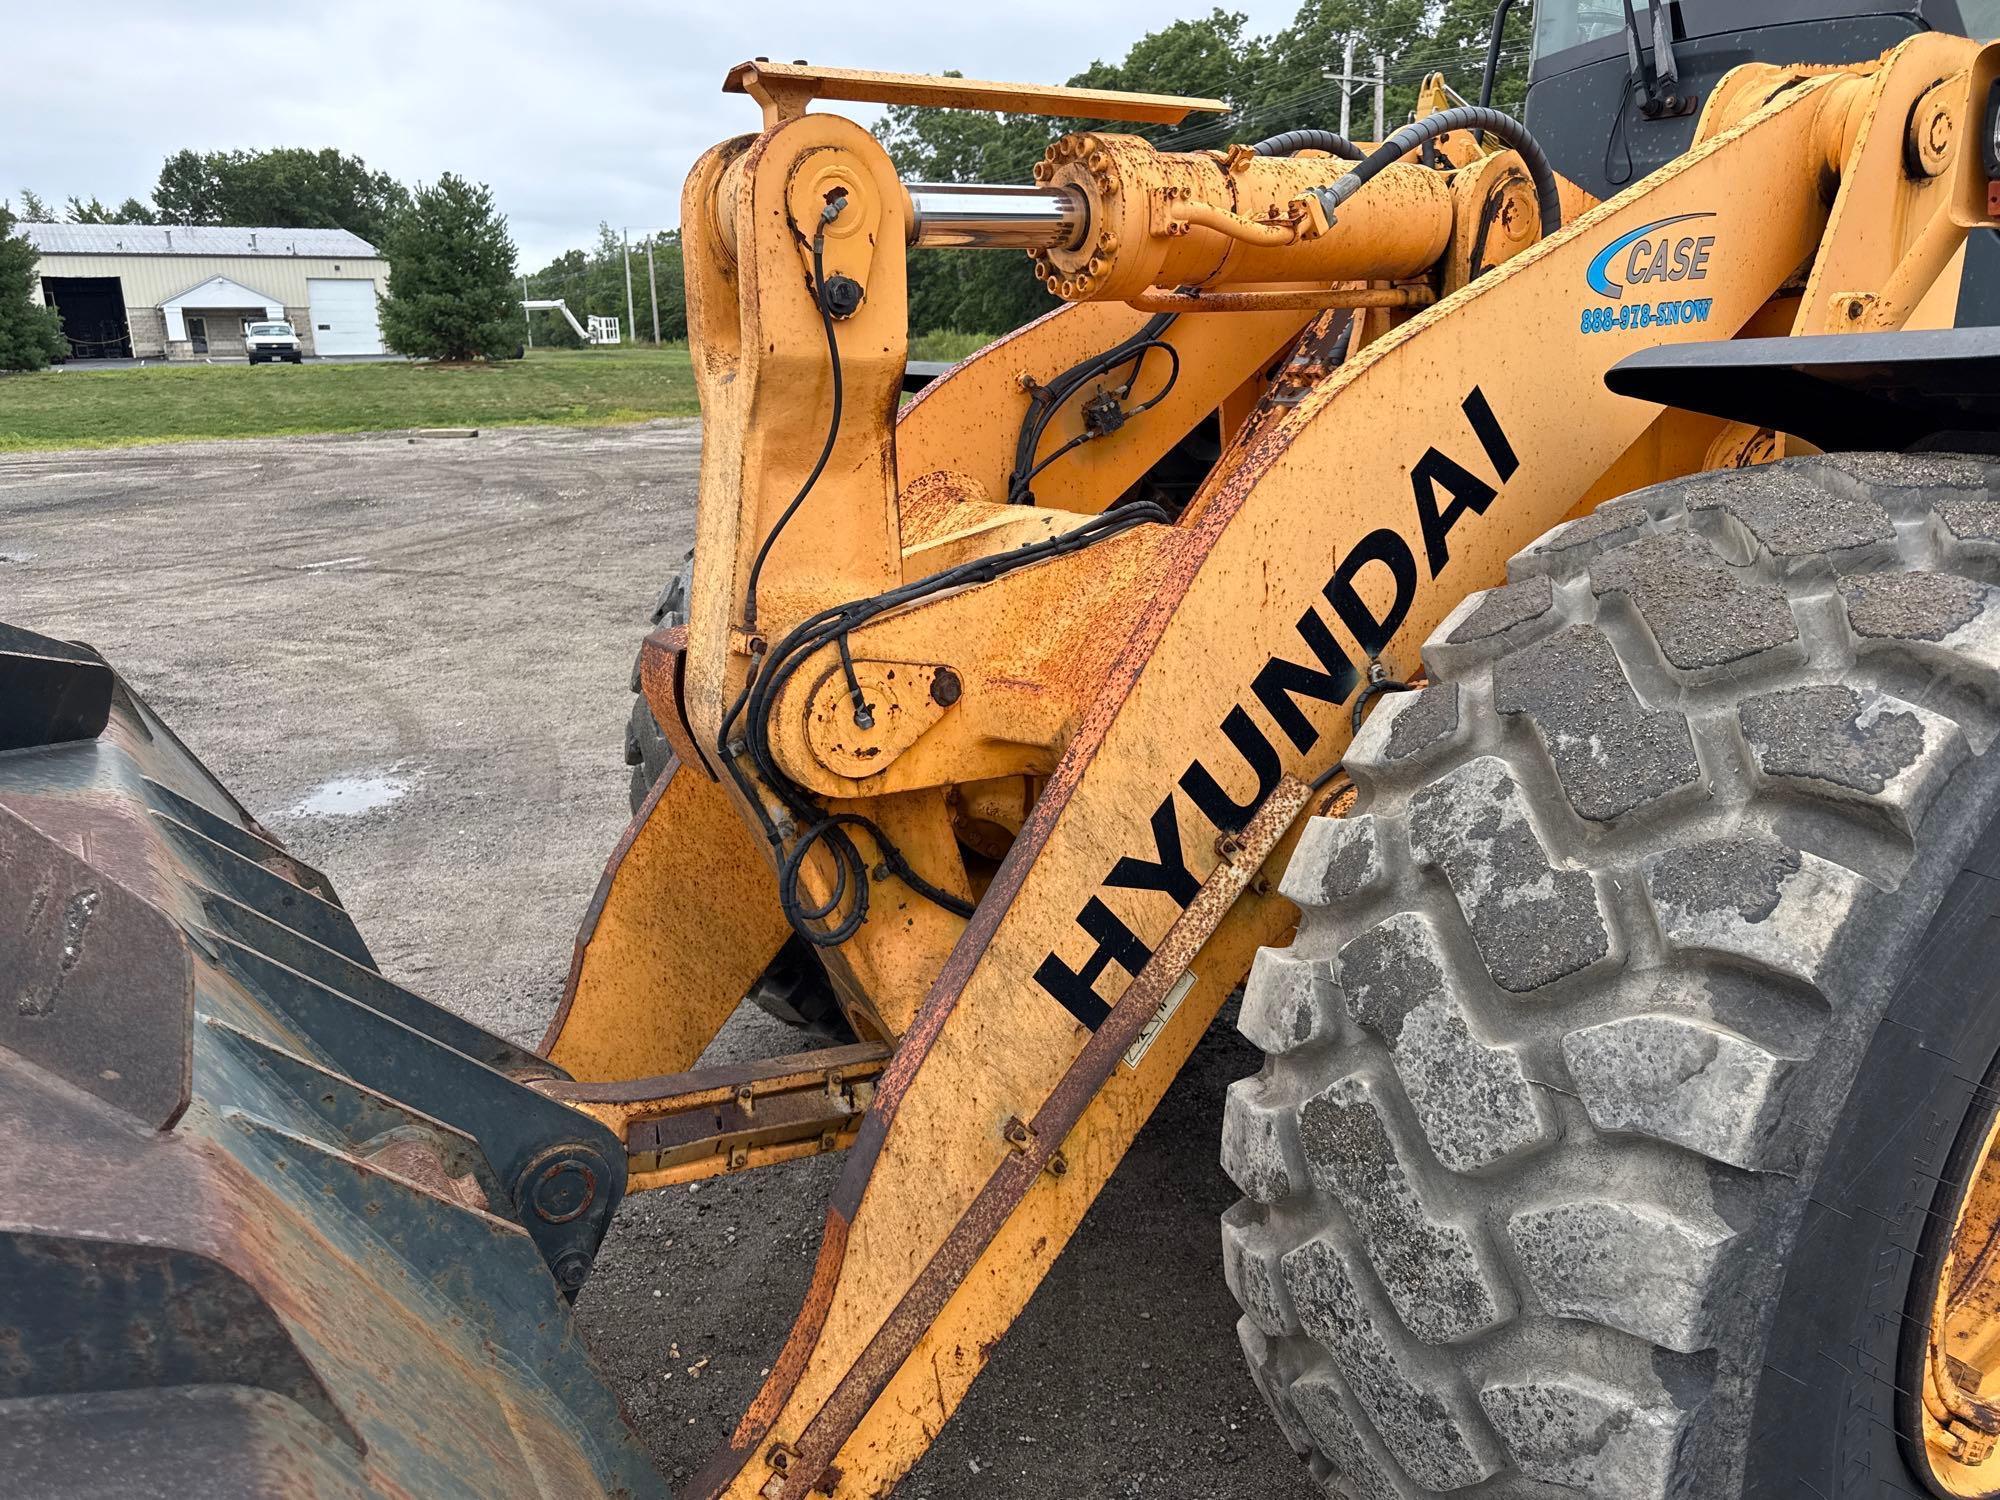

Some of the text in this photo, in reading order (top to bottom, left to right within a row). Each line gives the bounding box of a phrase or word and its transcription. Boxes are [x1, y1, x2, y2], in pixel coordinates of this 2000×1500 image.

[1626, 236, 1716, 284] CASE
[1581, 298, 1713, 334] 888-978-SNOW
[1032, 385, 1521, 1033] HYUNDAI
